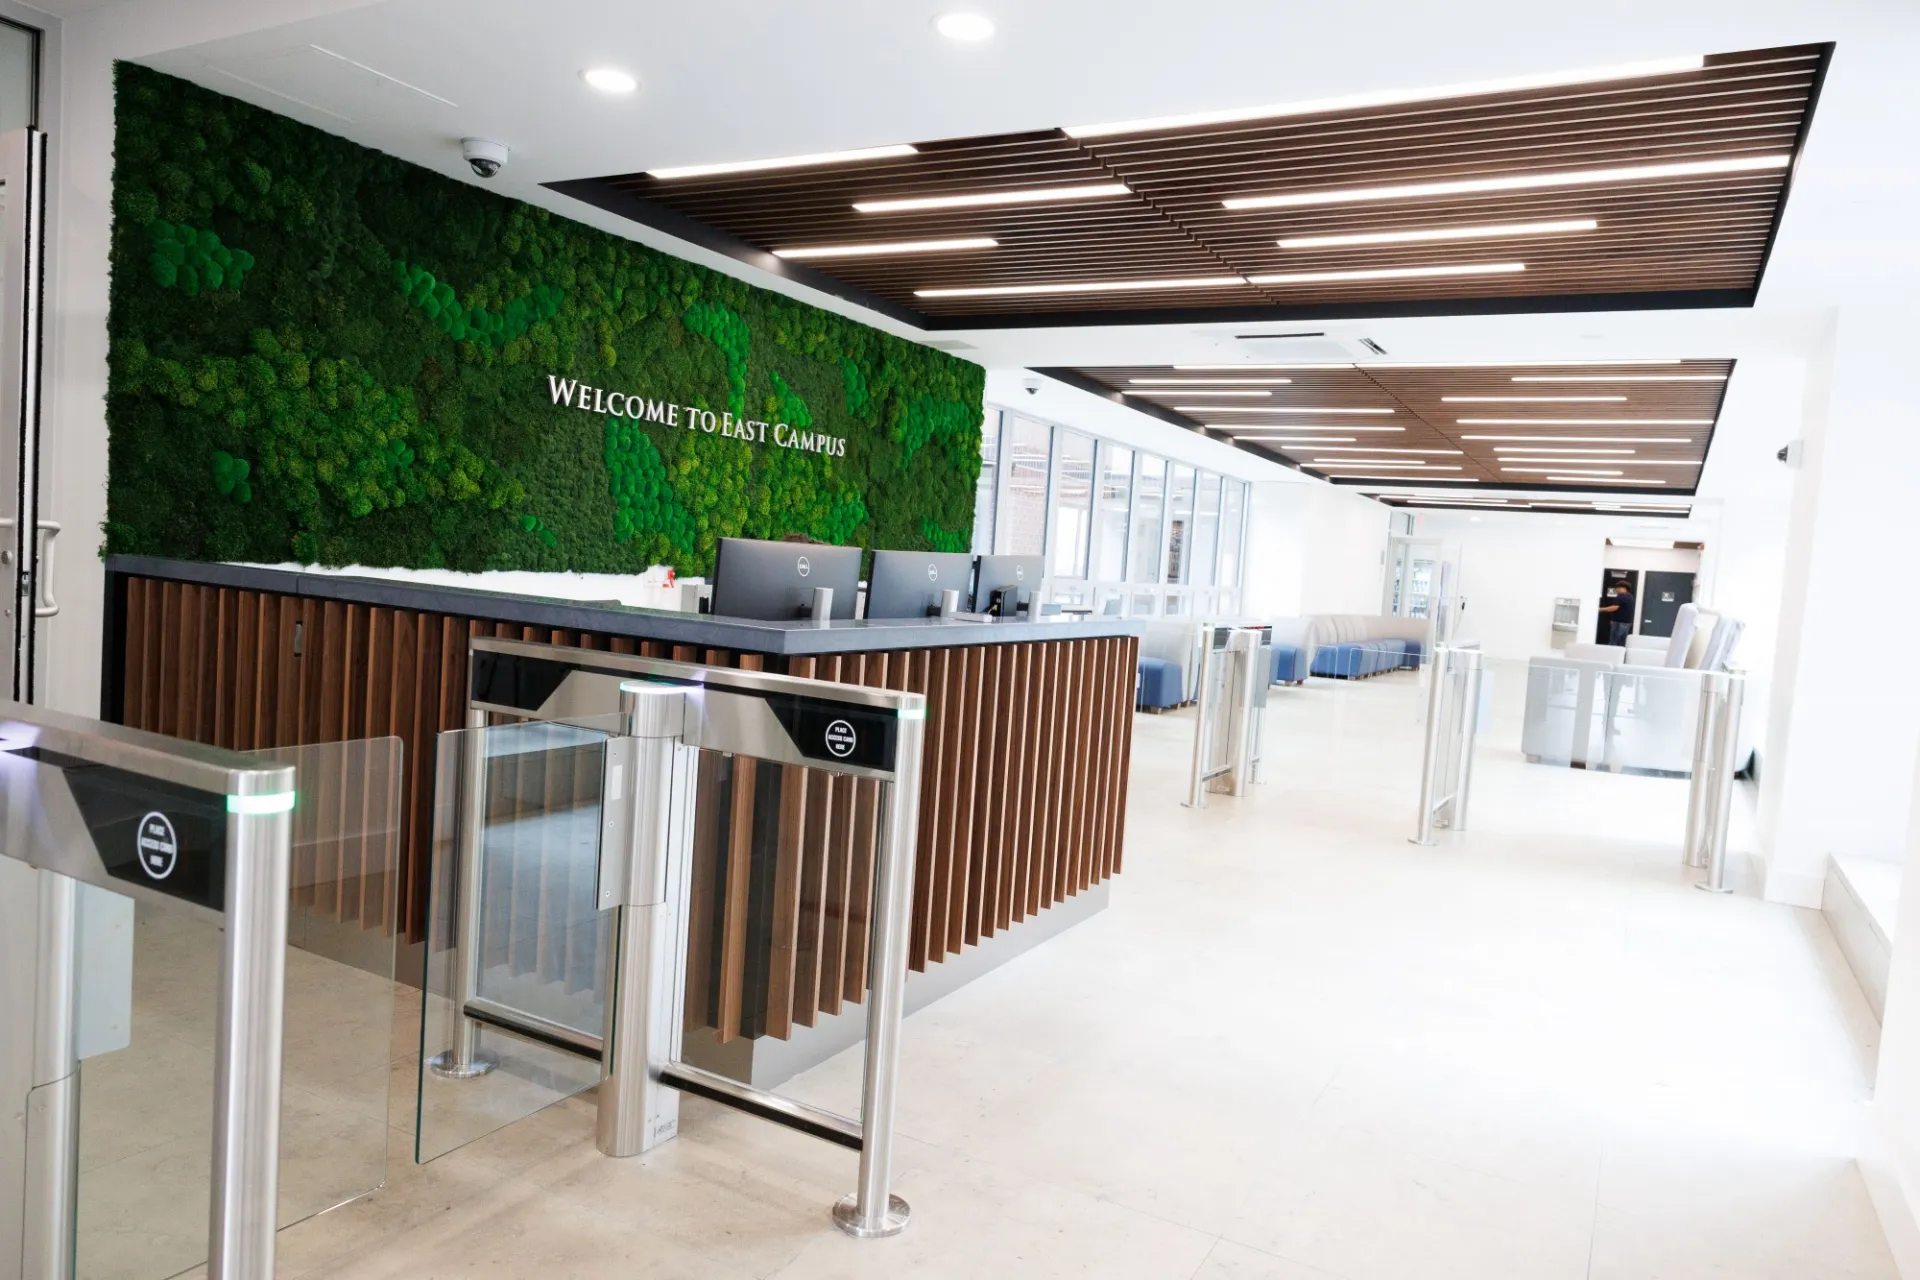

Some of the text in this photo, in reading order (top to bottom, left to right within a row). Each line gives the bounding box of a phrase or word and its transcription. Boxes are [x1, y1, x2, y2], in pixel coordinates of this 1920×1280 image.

[547, 374, 846, 457] WELCOME TO EAST CAMPUS
